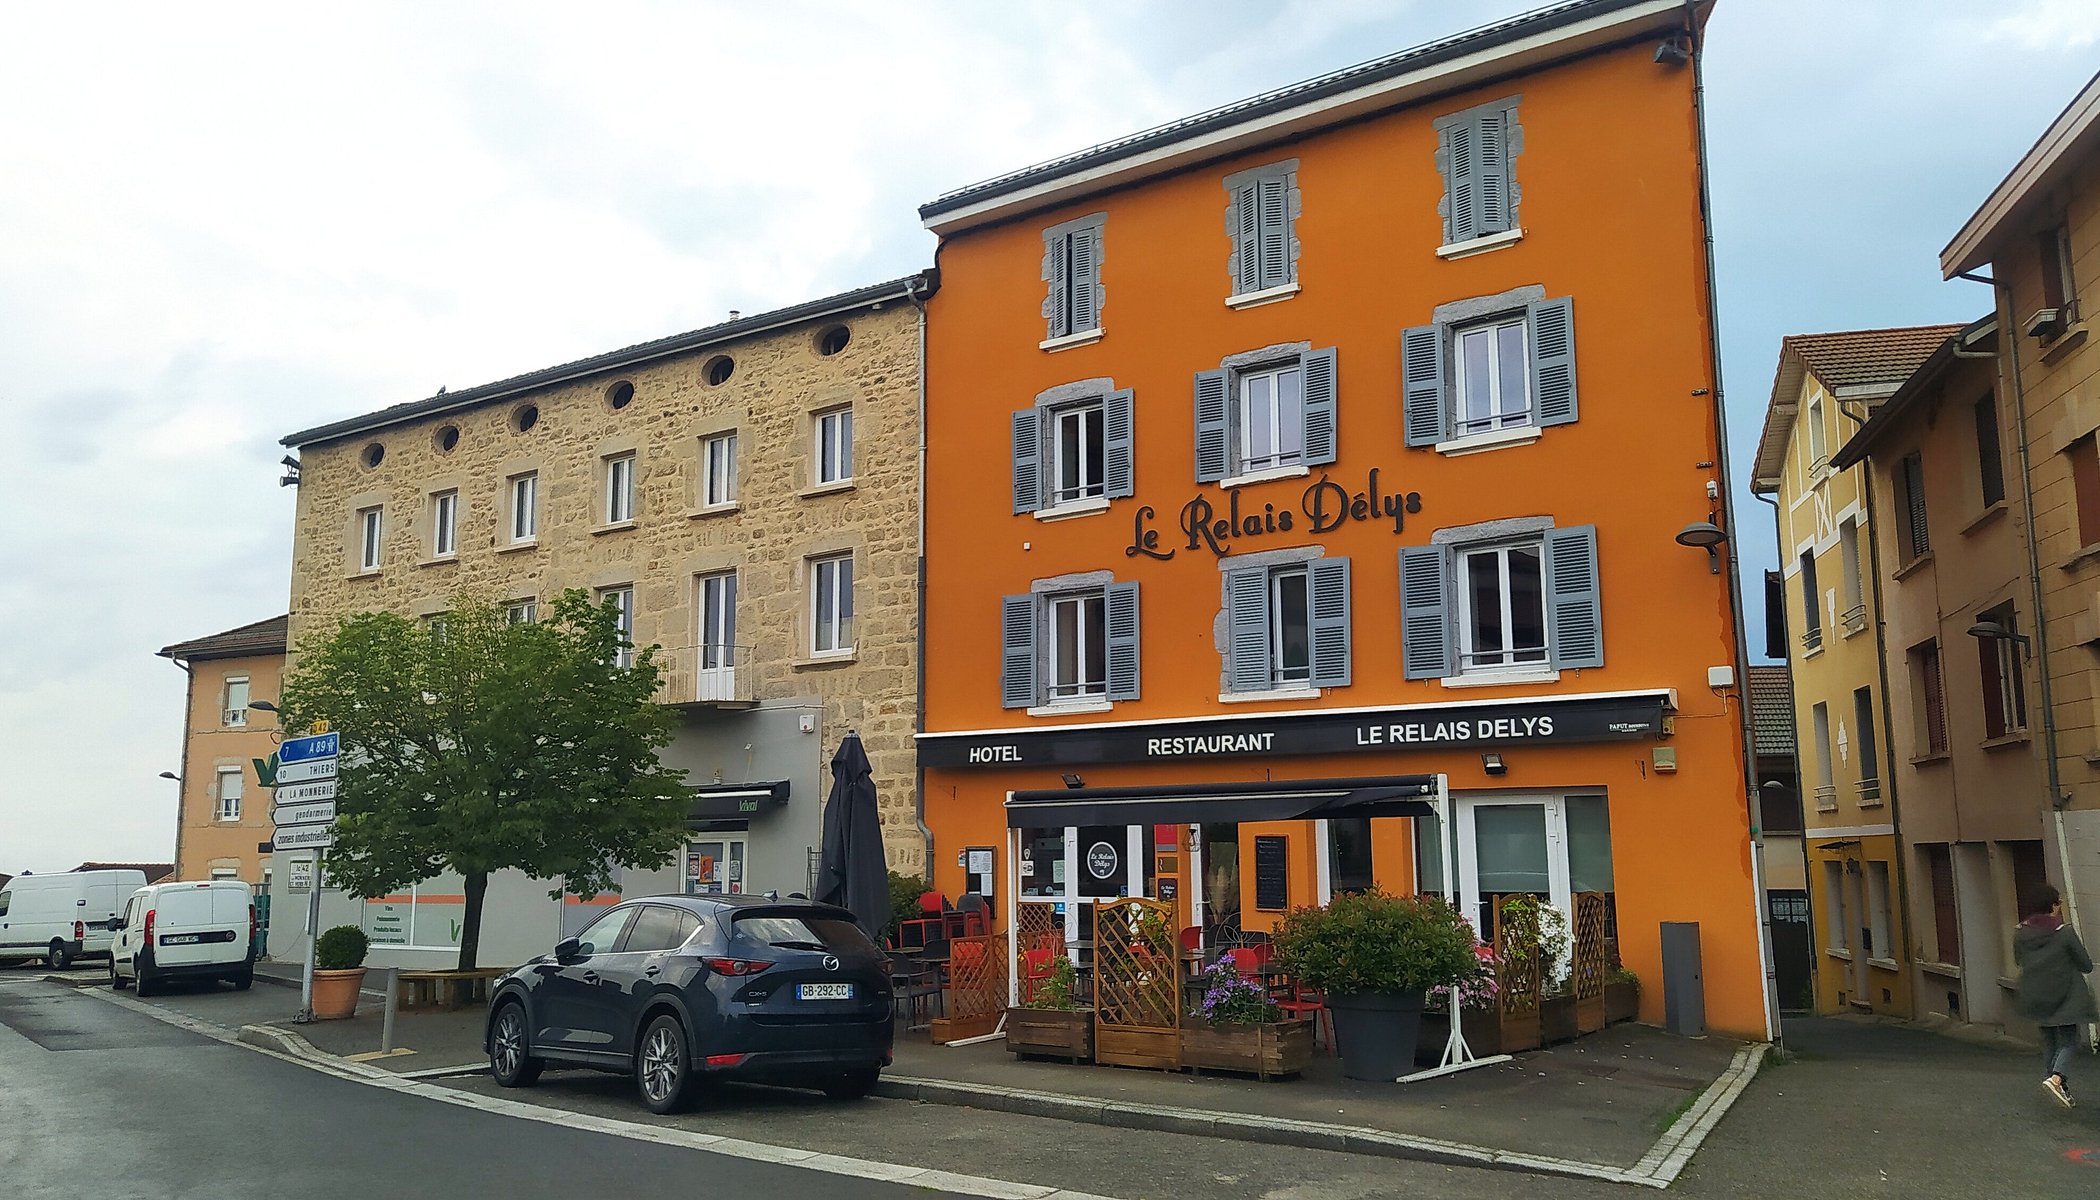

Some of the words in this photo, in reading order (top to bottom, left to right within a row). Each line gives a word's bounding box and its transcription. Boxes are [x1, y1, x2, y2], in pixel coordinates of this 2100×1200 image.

[1126, 506, 1175, 560] Le
[1180, 488, 1294, 557] Relais
[1302, 467, 1421, 534] Délys
[1357, 726, 1383, 745] LE
[1389, 720, 1470, 743] RELAIS
[1478, 717, 1554, 740] DELYS
[284, 746, 290, 757] 7
[309, 742, 315, 754] A
[316, 741, 326, 753] 89
[1148, 733, 1274, 755] RESTAURANT
[969, 746, 1022, 763] HOTEL
[279, 770, 287, 779] 10
[310, 763, 334, 775] THIERS
[279, 791, 283, 799] 4
[290, 790, 296, 799] LA
[299, 785, 333, 798] MONNERIE
[739, 799, 758, 811] Vival
[295, 808, 332, 821] gendarmerie
[278, 834, 294, 844] zones
[295, 829, 330, 843] industrielles
[802, 985, 847, 996] GB-292-CC
